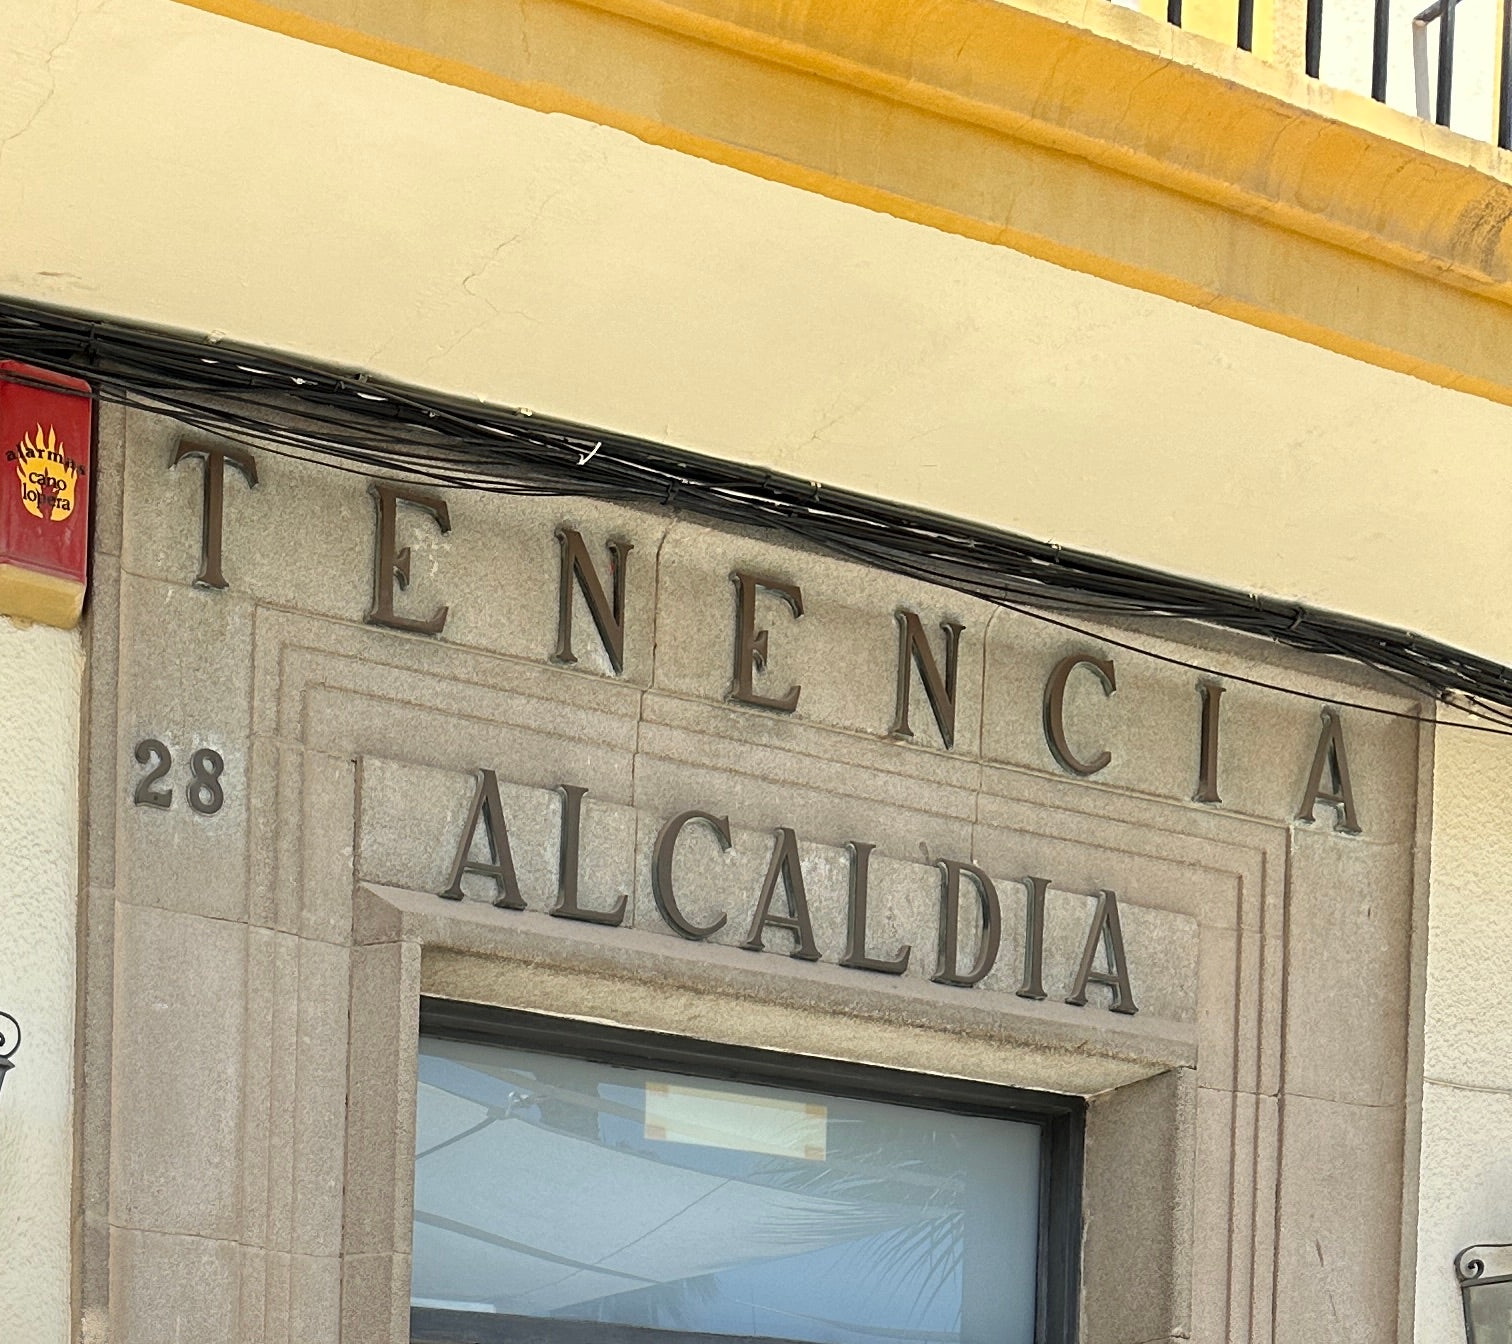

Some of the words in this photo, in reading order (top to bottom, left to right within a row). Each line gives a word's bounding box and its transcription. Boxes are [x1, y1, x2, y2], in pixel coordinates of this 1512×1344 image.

[5, 443, 86, 476] alarmas
[28, 471, 67, 491] cano
[22, 482, 71, 512] lopera
[170, 436, 1364, 834] TENENCIA
[134, 739, 226, 816] 28
[439, 767, 1140, 1016] ALCALDIA
